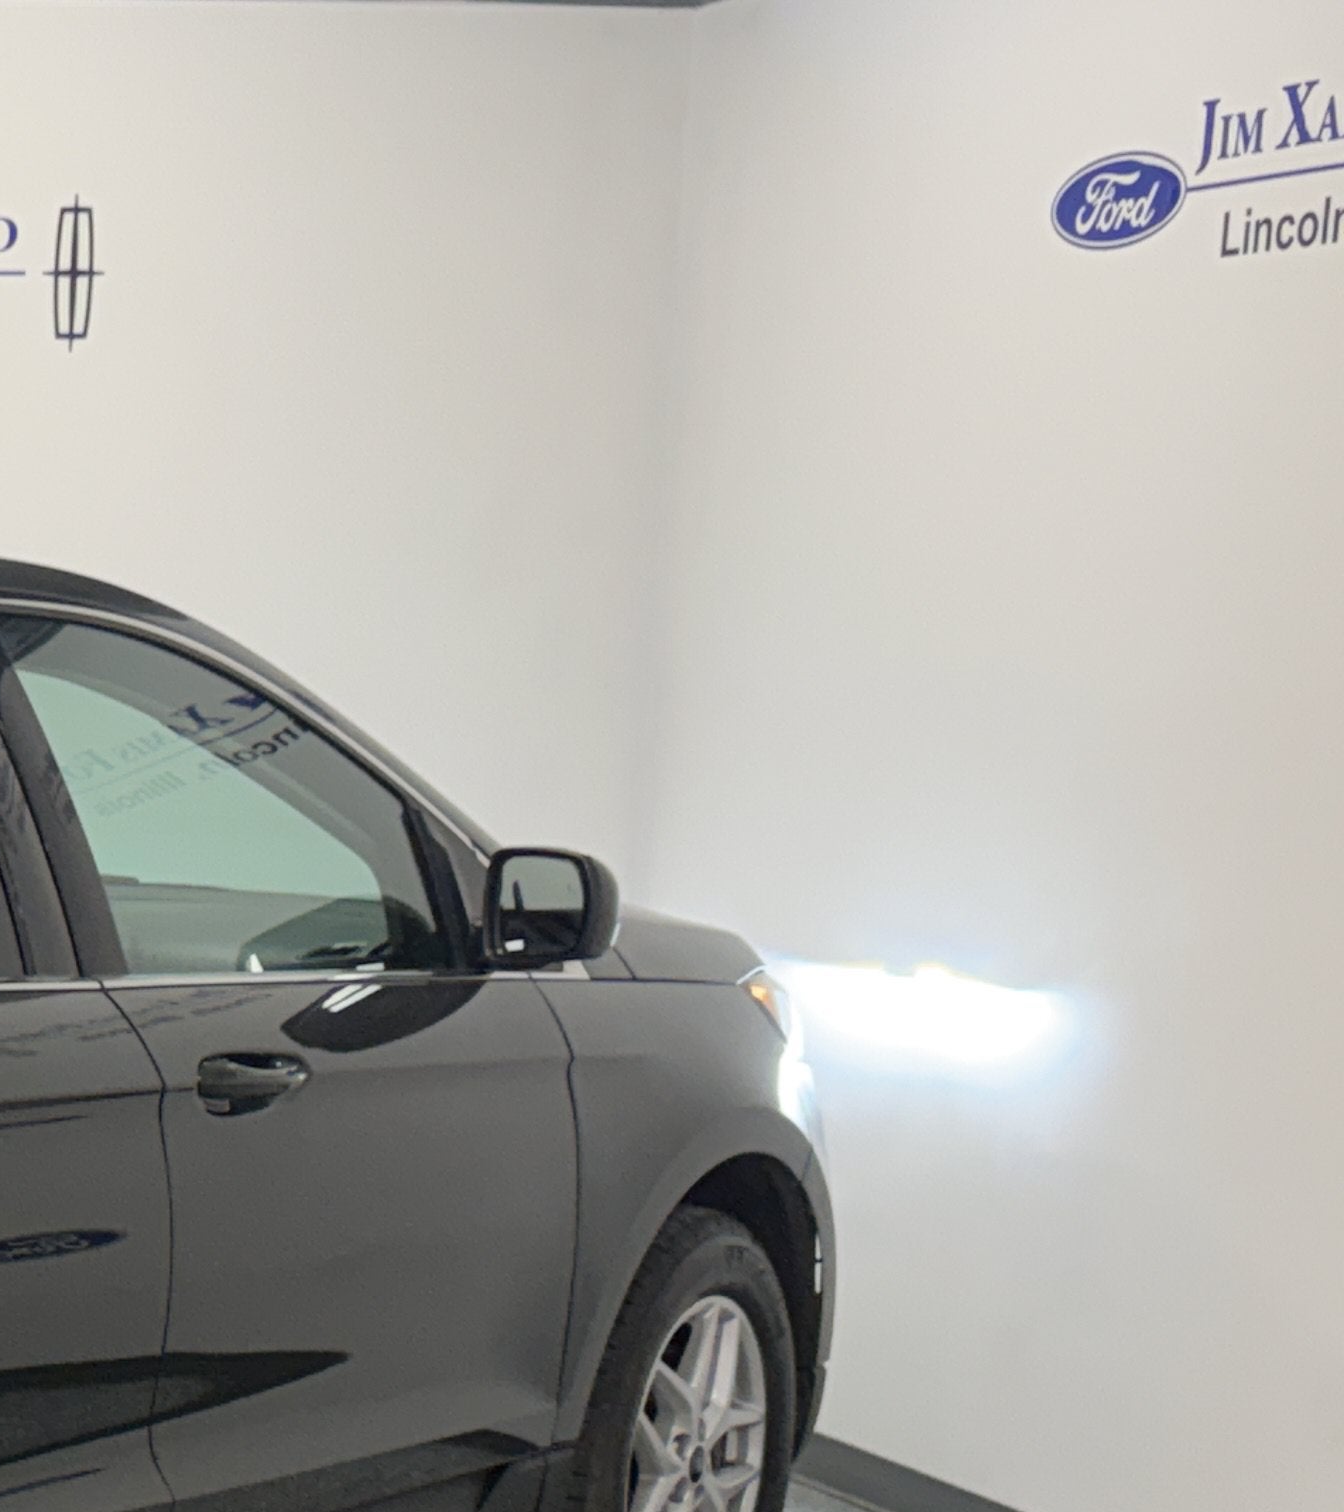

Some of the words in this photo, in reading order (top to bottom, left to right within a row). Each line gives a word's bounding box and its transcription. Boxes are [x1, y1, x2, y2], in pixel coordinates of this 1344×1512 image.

[1195, 98, 1268, 176] JIM
[1275, 79, 1344, 150] XA
[1075, 170, 1162, 236] Ford
